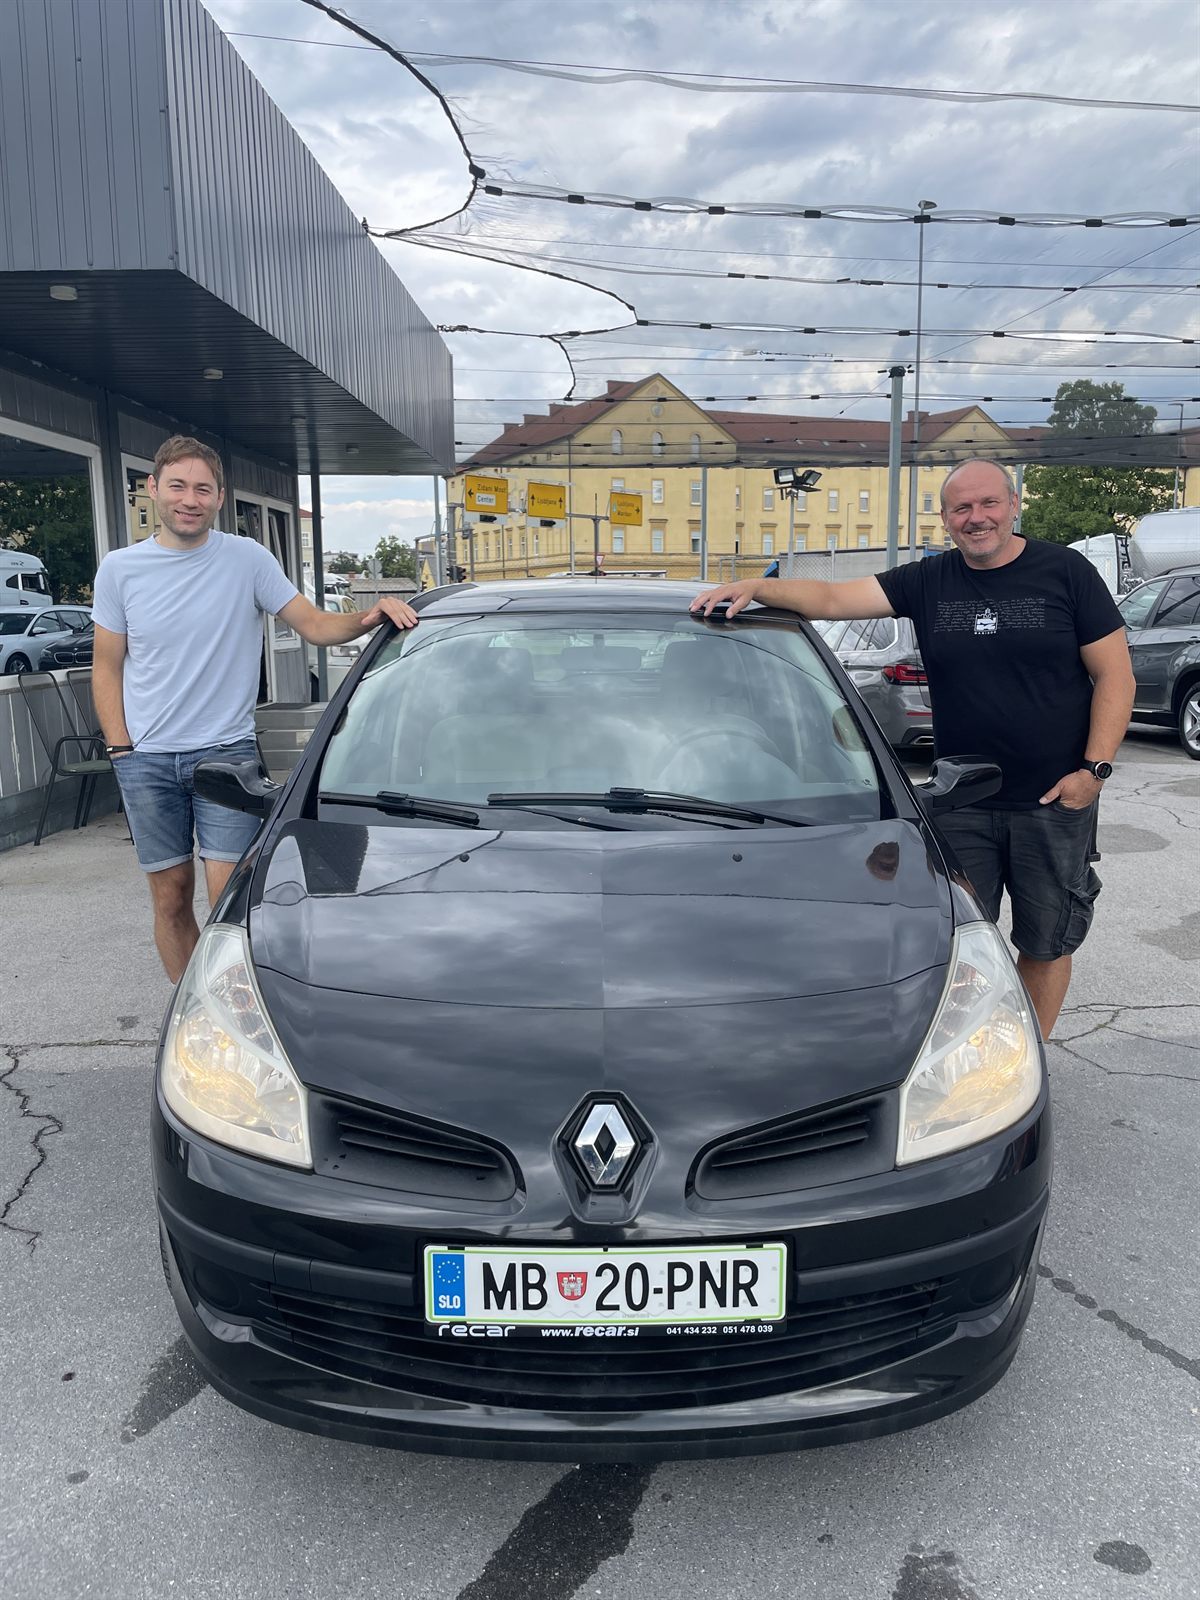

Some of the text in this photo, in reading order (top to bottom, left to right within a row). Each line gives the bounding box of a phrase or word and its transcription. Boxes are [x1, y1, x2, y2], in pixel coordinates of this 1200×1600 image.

[477, 483, 507, 494] Zidani Most
[477, 495, 495, 503] Center
[537, 497, 557, 506] Ljubljana
[482, 1259, 759, 1312] MB 20-PNR
[438, 1294, 461, 1309] SLO
[438, 1324, 516, 1337] recar
[541, 1325, 640, 1337] www.recar.si
[666, 1325, 773, 1335] 041 434 232 051 478 039
